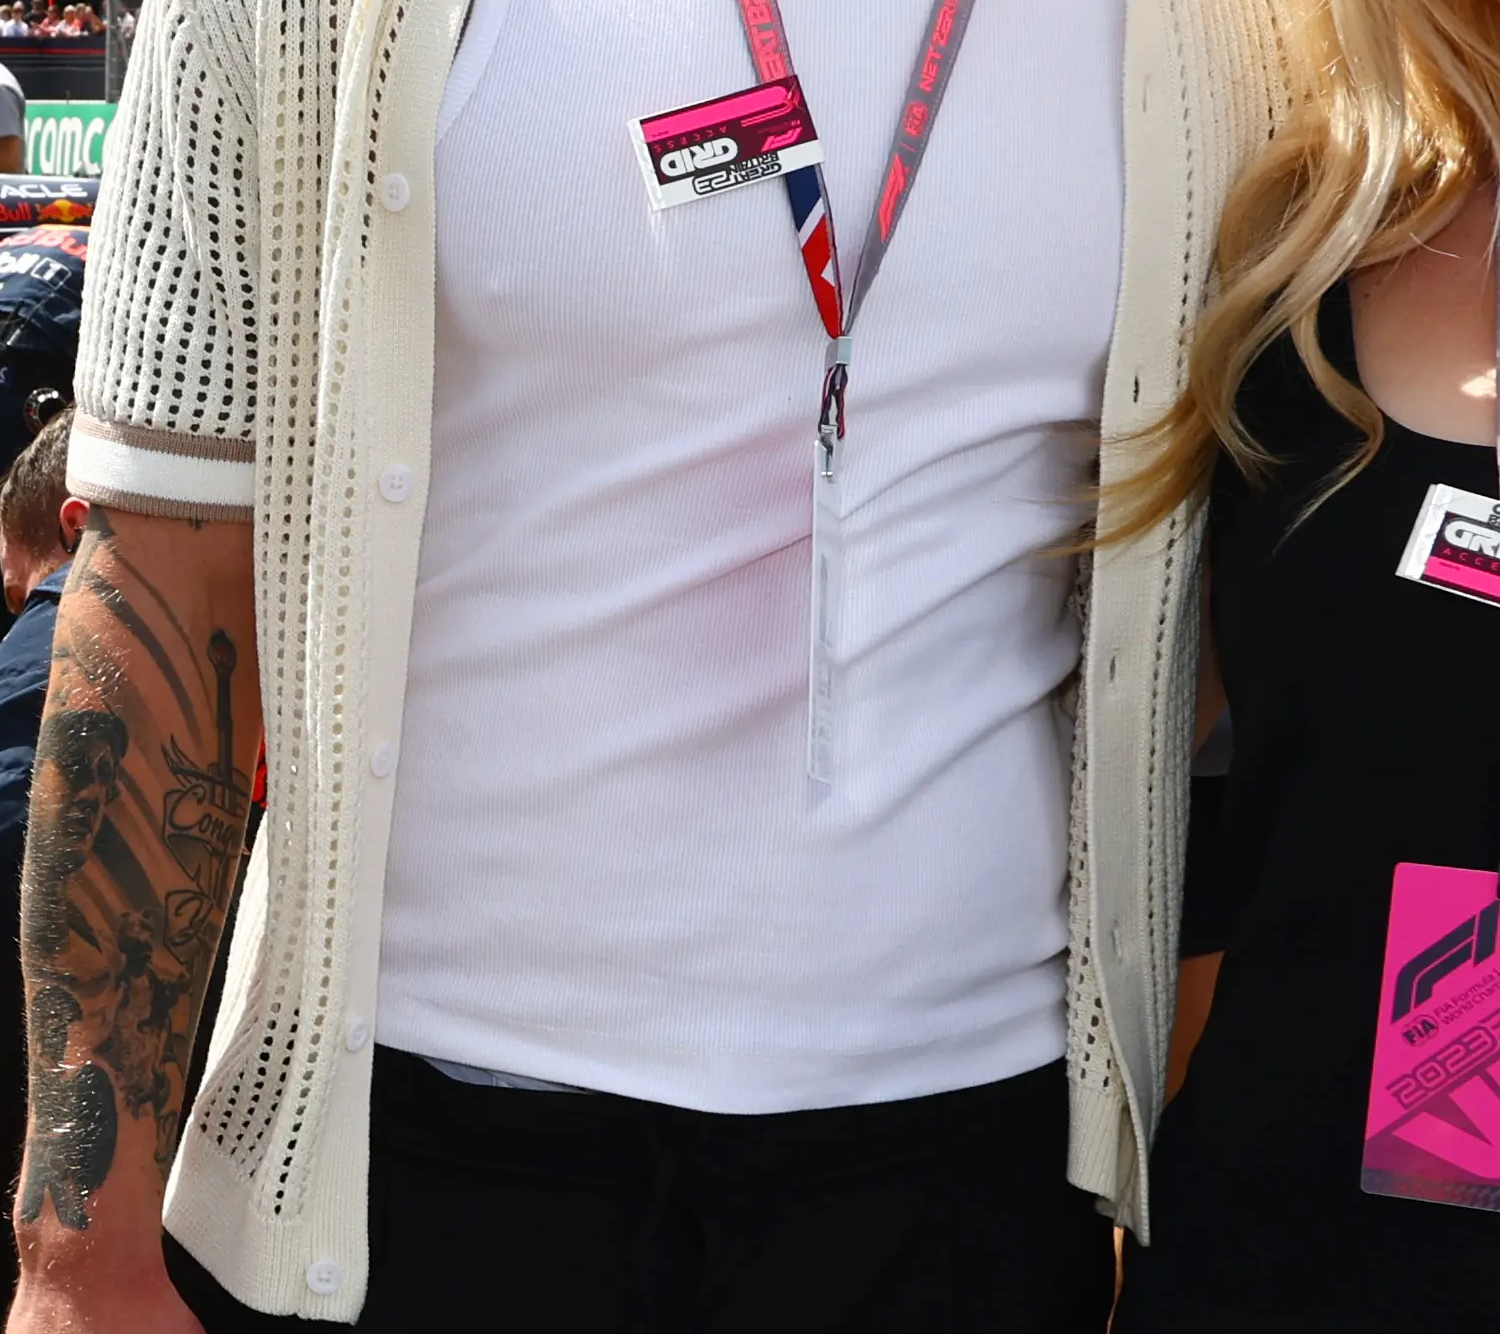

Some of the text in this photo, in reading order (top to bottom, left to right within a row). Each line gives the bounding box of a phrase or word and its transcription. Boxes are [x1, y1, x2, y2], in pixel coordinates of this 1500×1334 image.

[917, 49, 944, 93] NET
[25, 116, 107, 176] ramc
[652, 126, 728, 154] ACCESS
[659, 136, 739, 178] GRID
[728, 151, 781, 174] BRITAIN
[1450, 973, 1497, 1010] Formula
[1441, 998, 1475, 1027] World
[1402, 1018, 1437, 1046] FIA
[1390, 1028, 1494, 1108] 2023
